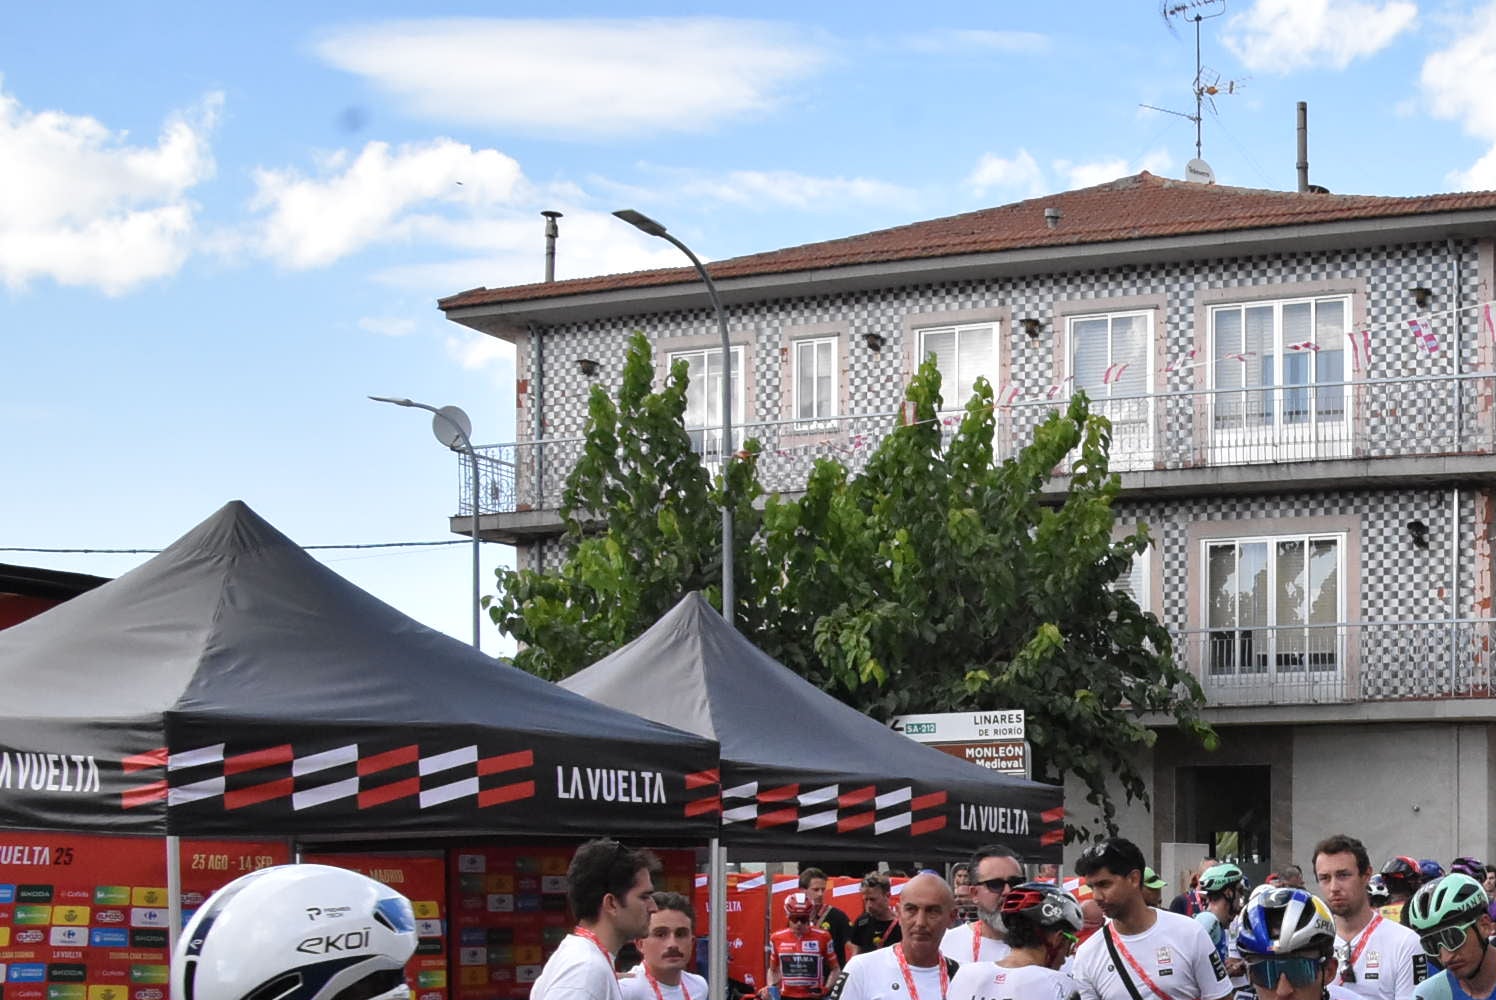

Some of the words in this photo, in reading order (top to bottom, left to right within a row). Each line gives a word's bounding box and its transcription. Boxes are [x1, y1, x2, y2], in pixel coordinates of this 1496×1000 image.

[973, 714, 1023, 725] LINARES
[906, 723, 936, 734] SA-212
[965, 746, 1023, 758] MONLEÓN
[975, 758, 1023, 768] Medieval
[16, 753, 100, 793] VUELTA
[557, 765, 584, 800] LA
[586, 768, 667, 804] VUELTA
[960, 804, 978, 831] LA
[978, 805, 1029, 835] VUELTA
[0, 846, 50, 865] UELTA
[54, 848, 74, 865] 25
[191, 854, 206, 869] 23
[208, 855, 228, 870] AGO
[239, 855, 251, 870] 14
